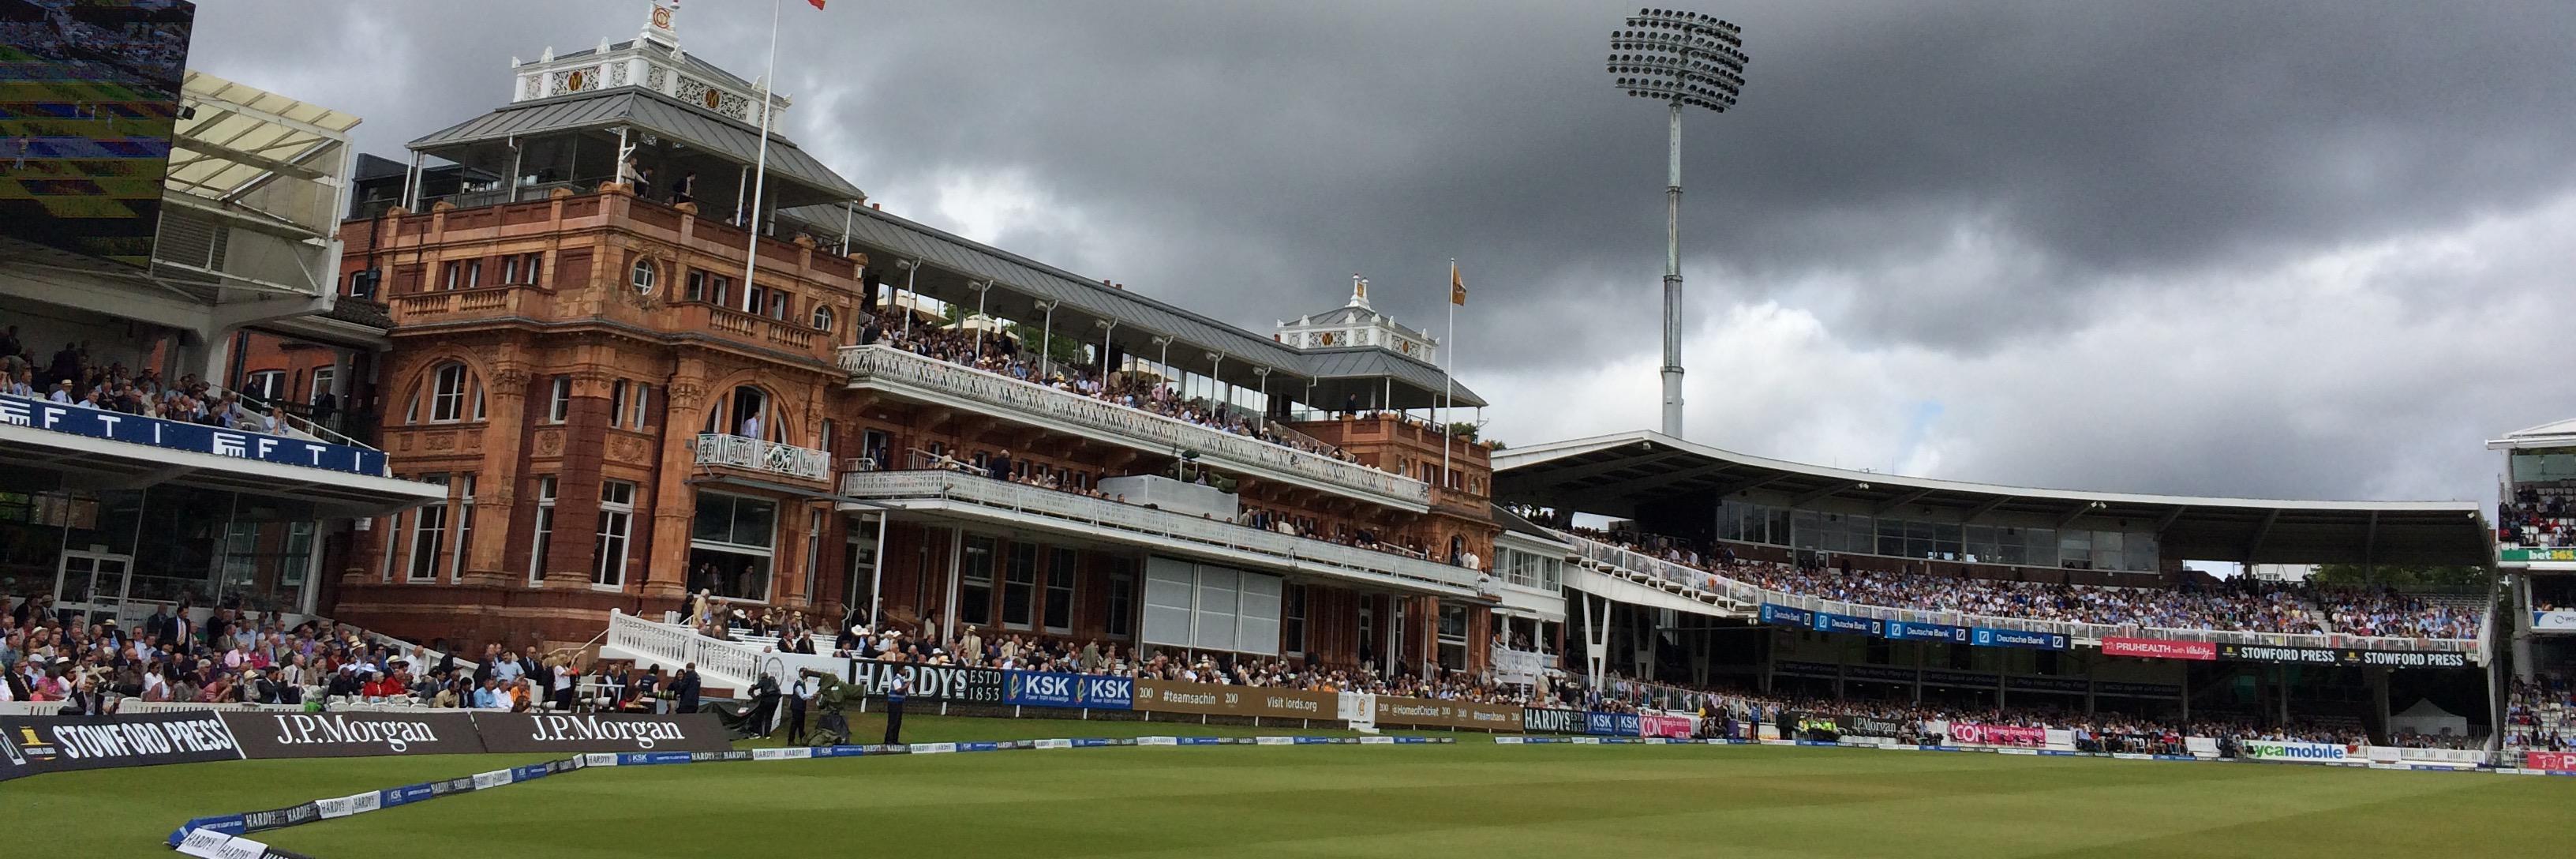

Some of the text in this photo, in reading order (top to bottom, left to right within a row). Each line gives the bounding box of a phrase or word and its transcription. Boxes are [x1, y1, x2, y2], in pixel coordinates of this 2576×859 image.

[1832, 619, 1866, 630] Deutsche Bank
[1907, 627, 1949, 638] Deutsche Bank
[1997, 635, 2045, 645] Deutsche Bank
[2116, 642, 2170, 653] PRUHEALTH
[2241, 647, 2335, 662] STOWFORD PRESS
[2364, 651, 2463, 666] STOWFORD PRESS
[855, 662, 968, 700] HARDYS
[970, 670, 1002, 685] ESTD
[1026, 675, 1069, 696] KSK
[1091, 679, 1130, 699] KSK
[1139, 687, 1153, 699] 200
[969, 687, 1000, 701] 1853
[1163, 690, 1215, 705] #teamsachin
[1225, 692, 1237, 704] 200
[1267, 696, 1317, 712] Visit lords.org
[1525, 709, 1571, 731] HARDYS
[1593, 714, 1612, 728] KSK
[1620, 715, 1639, 730] KSK
[1852, 717, 1896, 733] J.P.Morgan
[53, 718, 232, 759] STOWFORD PRESS
[274, 715, 438, 752] J.P.Morgan
[531, 715, 685, 748] J.P.Morgan
